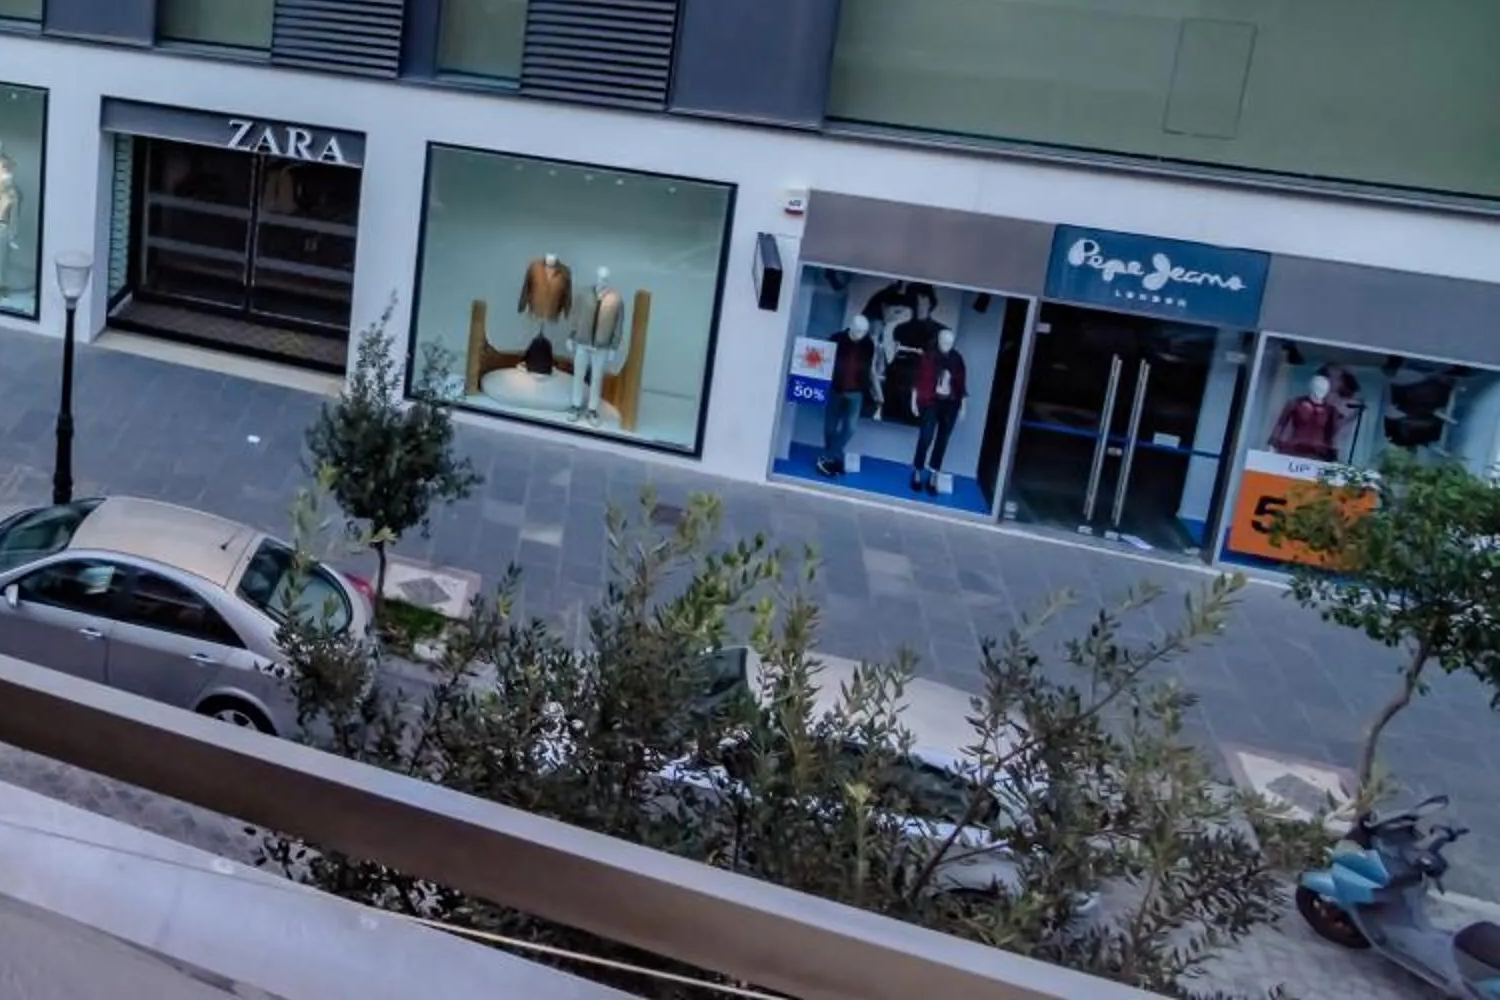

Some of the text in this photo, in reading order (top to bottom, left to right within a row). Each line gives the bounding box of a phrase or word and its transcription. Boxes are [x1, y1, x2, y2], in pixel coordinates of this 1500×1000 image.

[227, 119, 347, 164] ZARA
[1068, 239, 1247, 291] Pepe Jeans
